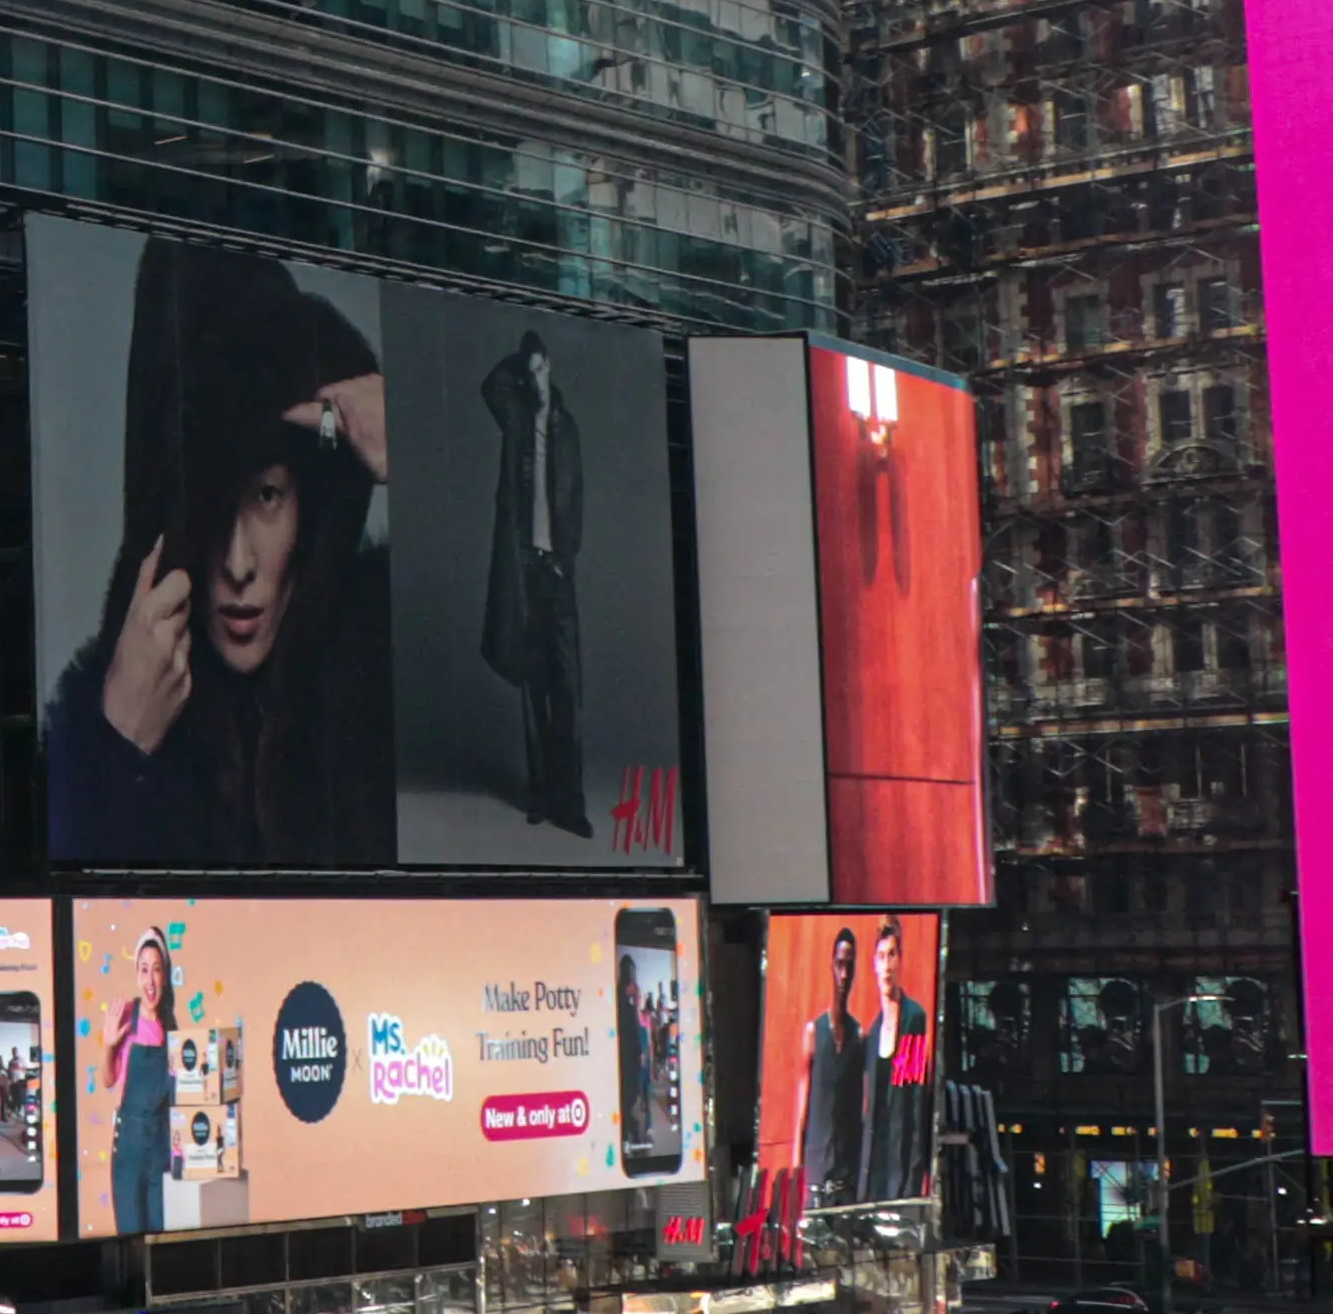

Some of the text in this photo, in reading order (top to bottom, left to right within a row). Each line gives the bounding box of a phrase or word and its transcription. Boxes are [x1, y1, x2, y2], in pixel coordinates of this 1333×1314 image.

[609, 766, 678, 855] H&M
[483, 981, 582, 1018] Make Potty
[282, 1027, 338, 1060] Millie
[476, 1026, 590, 1064] Training Fun!
[485, 1104, 571, 1130] New & only at
[663, 1216, 705, 1246] H&M
